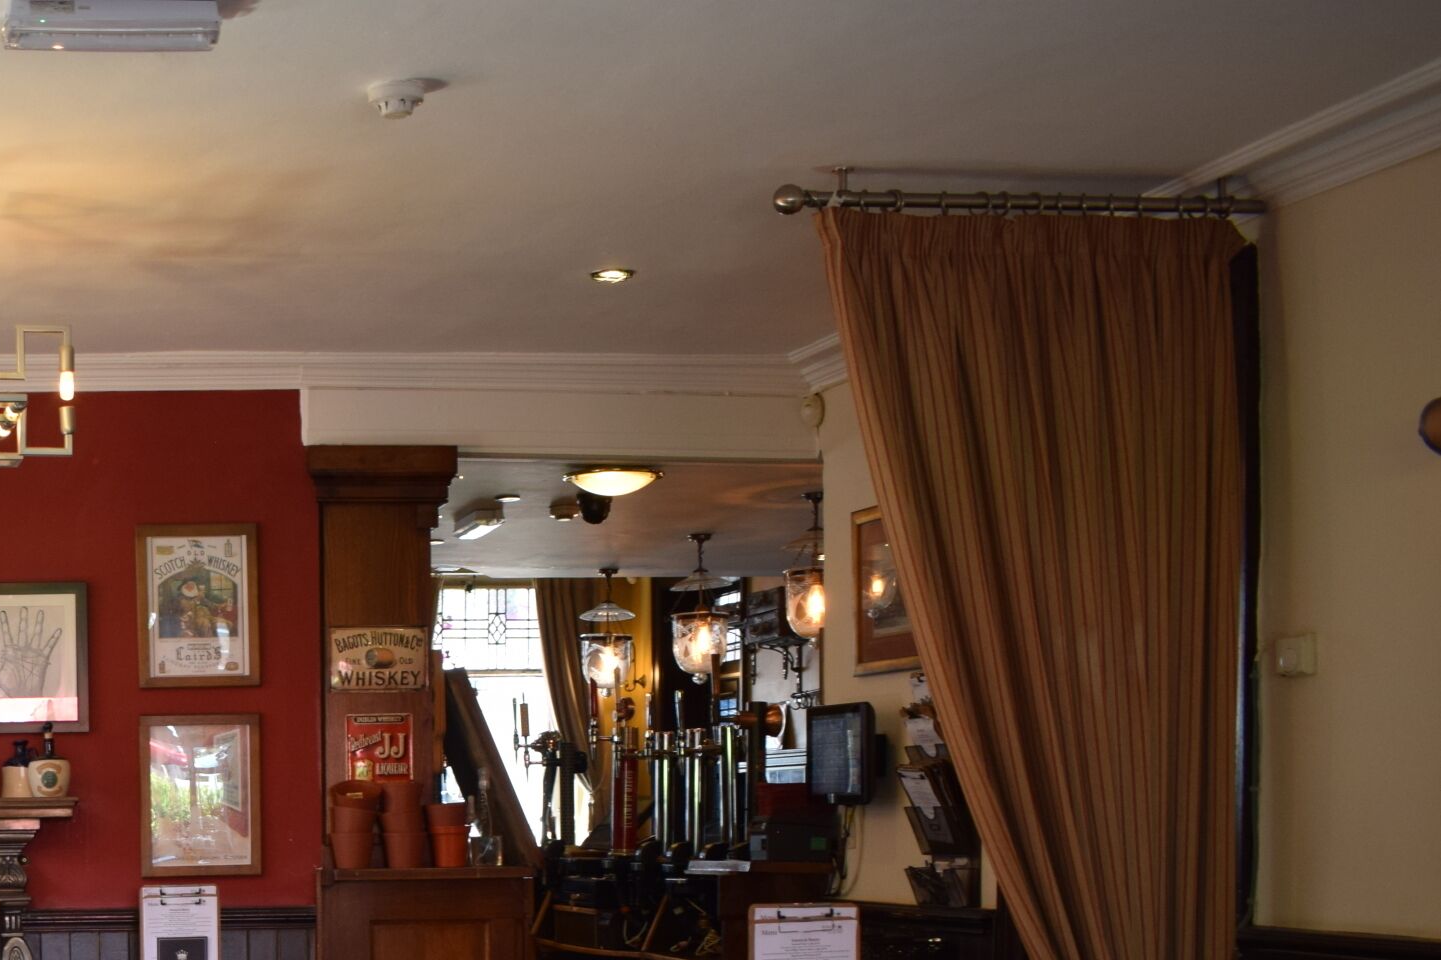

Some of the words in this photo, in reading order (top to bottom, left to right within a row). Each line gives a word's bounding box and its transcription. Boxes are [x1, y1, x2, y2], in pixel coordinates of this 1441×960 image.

[154, 556, 187, 580] SCOTCH
[207, 554, 242, 578] WHISKEY
[370, 630, 405, 647] HUTTON
[345, 657, 361, 665] FINE
[399, 656, 414, 664] OLD
[338, 670, 422, 687] WHISKEY
[374, 732, 406, 759] JJ
[375, 762, 409, 775] LIQUEUR
